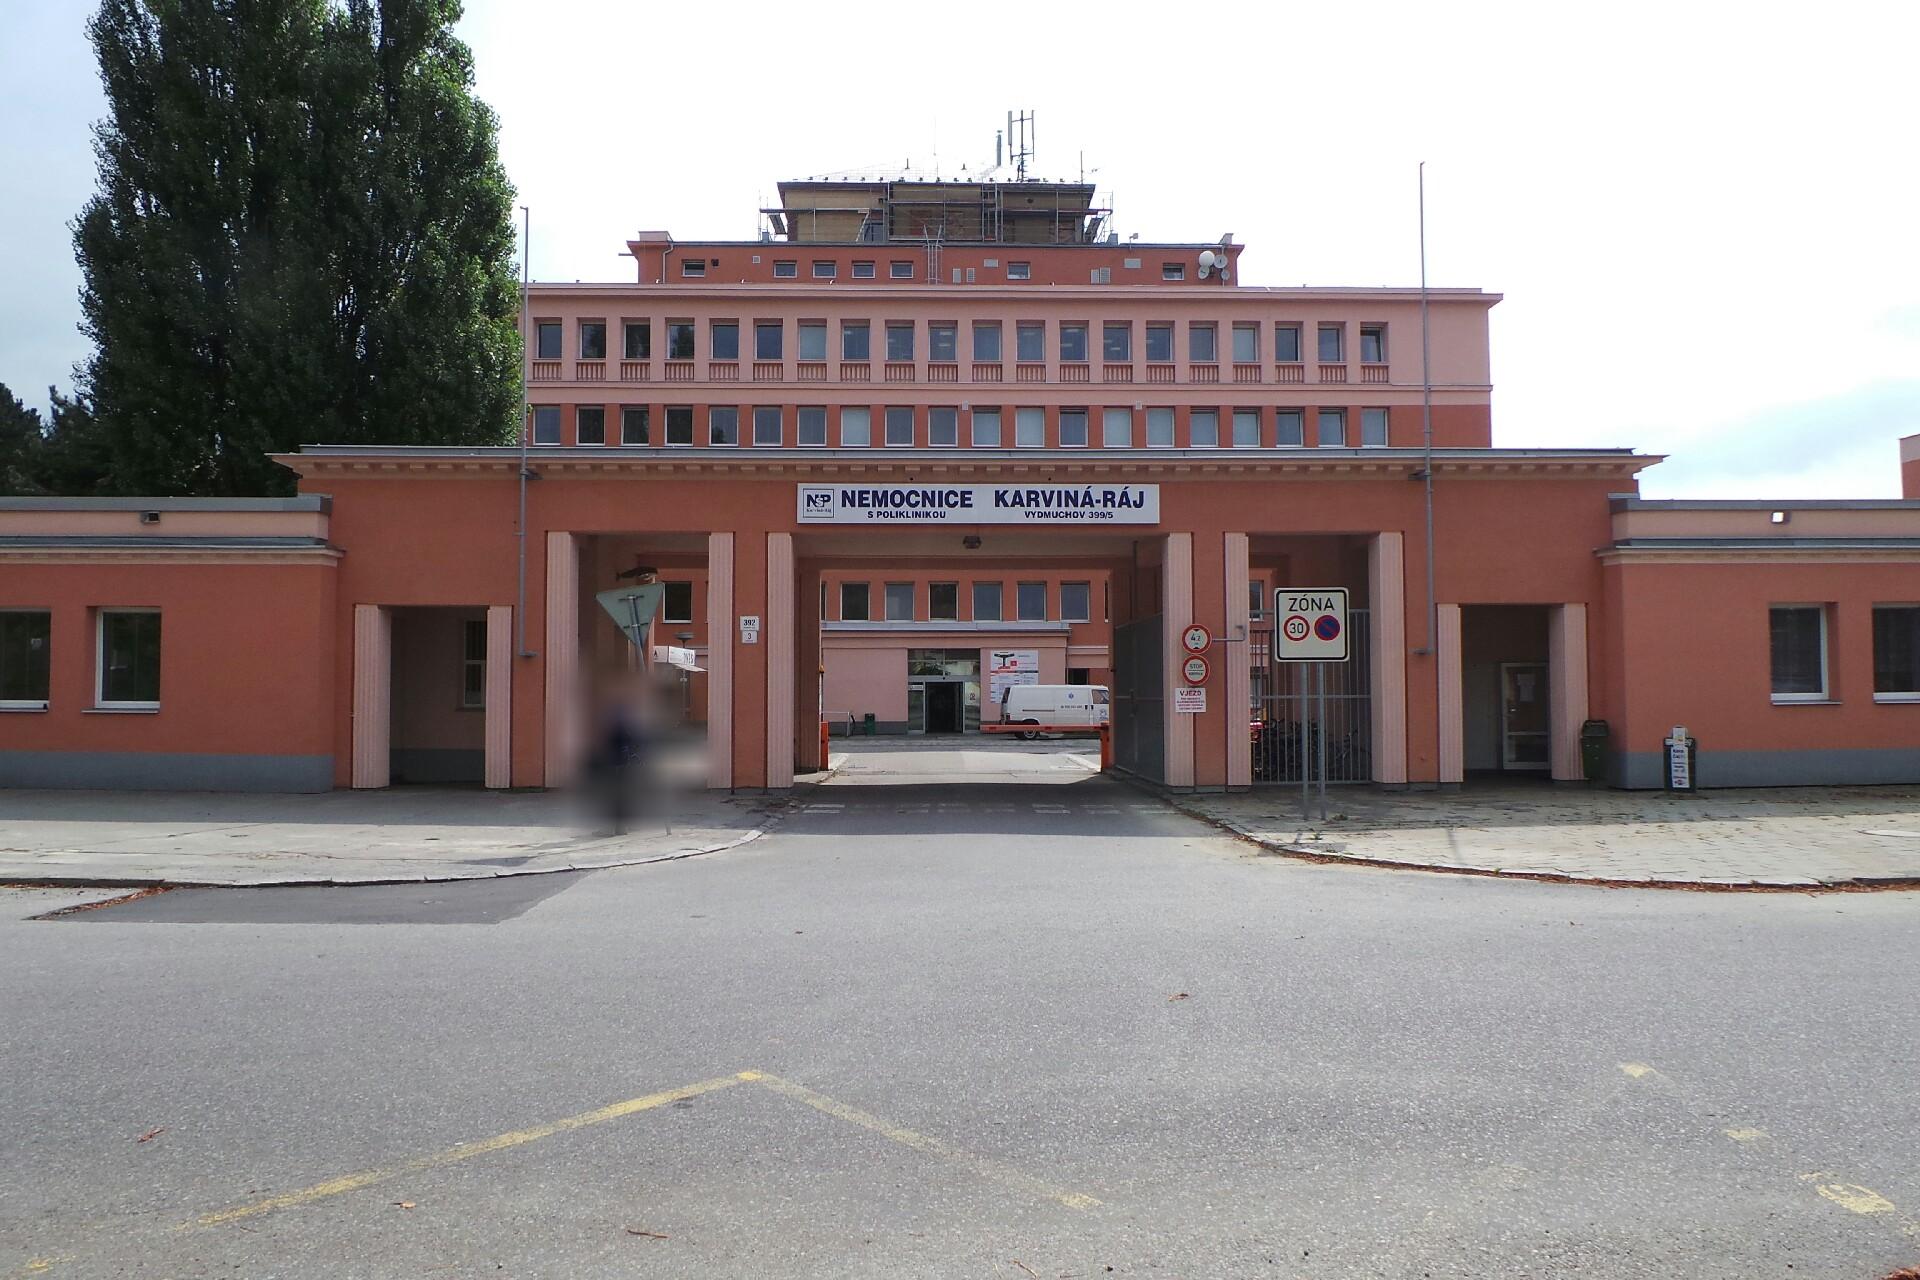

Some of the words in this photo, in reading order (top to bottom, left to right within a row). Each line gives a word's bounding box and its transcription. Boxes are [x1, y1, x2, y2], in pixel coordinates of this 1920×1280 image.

[841, 490, 973, 508] NEMOCNICE
[994, 485, 1145, 509] KARVINÁ-RÁJ
[867, 510, 874, 519] S
[877, 510, 946, 519] POLIKLINIKOU
[1024, 511, 1086, 519] VYDMUCHOV
[1088, 511, 1114, 519] 399/5
[1288, 593, 1335, 612] ZÓNA
[1289, 622, 1304, 634] 30
